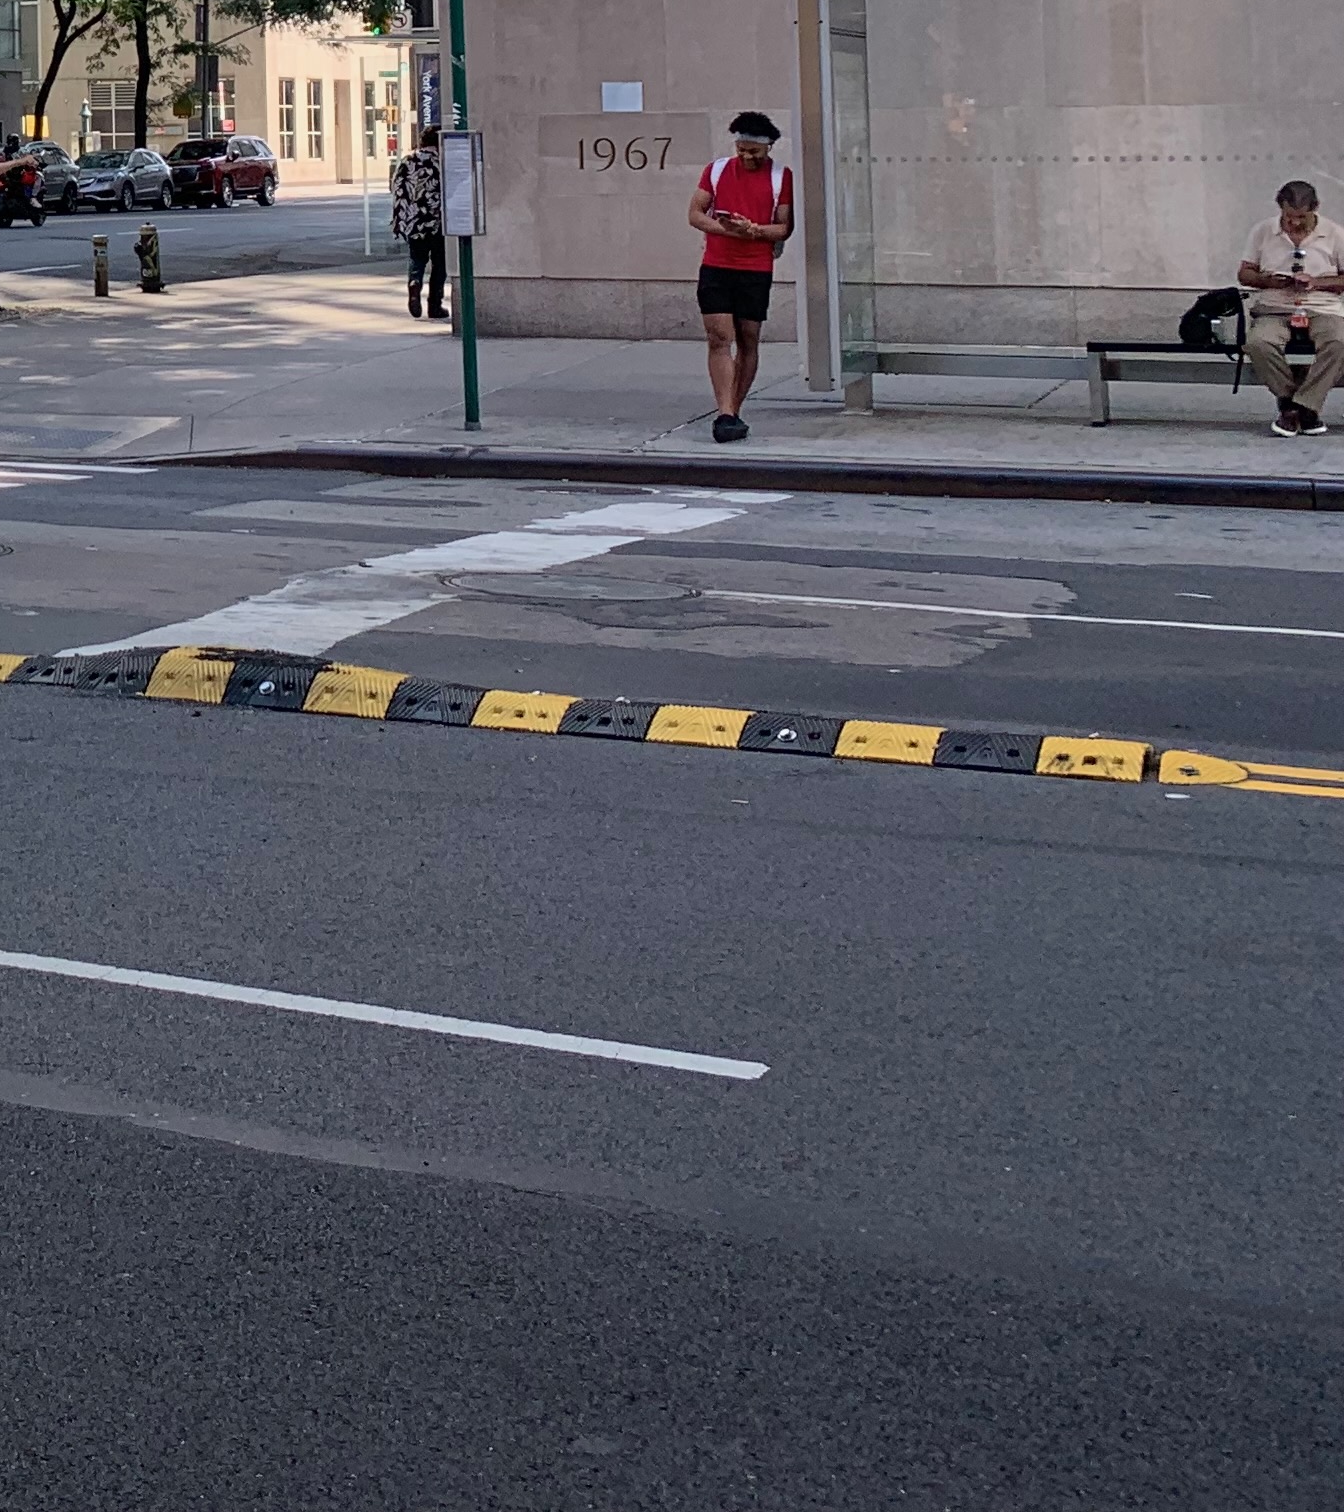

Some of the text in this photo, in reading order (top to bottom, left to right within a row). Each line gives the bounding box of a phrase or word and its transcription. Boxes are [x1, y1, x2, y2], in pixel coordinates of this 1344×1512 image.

[422, 70, 432, 126] York Avenu
[578, 136, 672, 172] 1967
